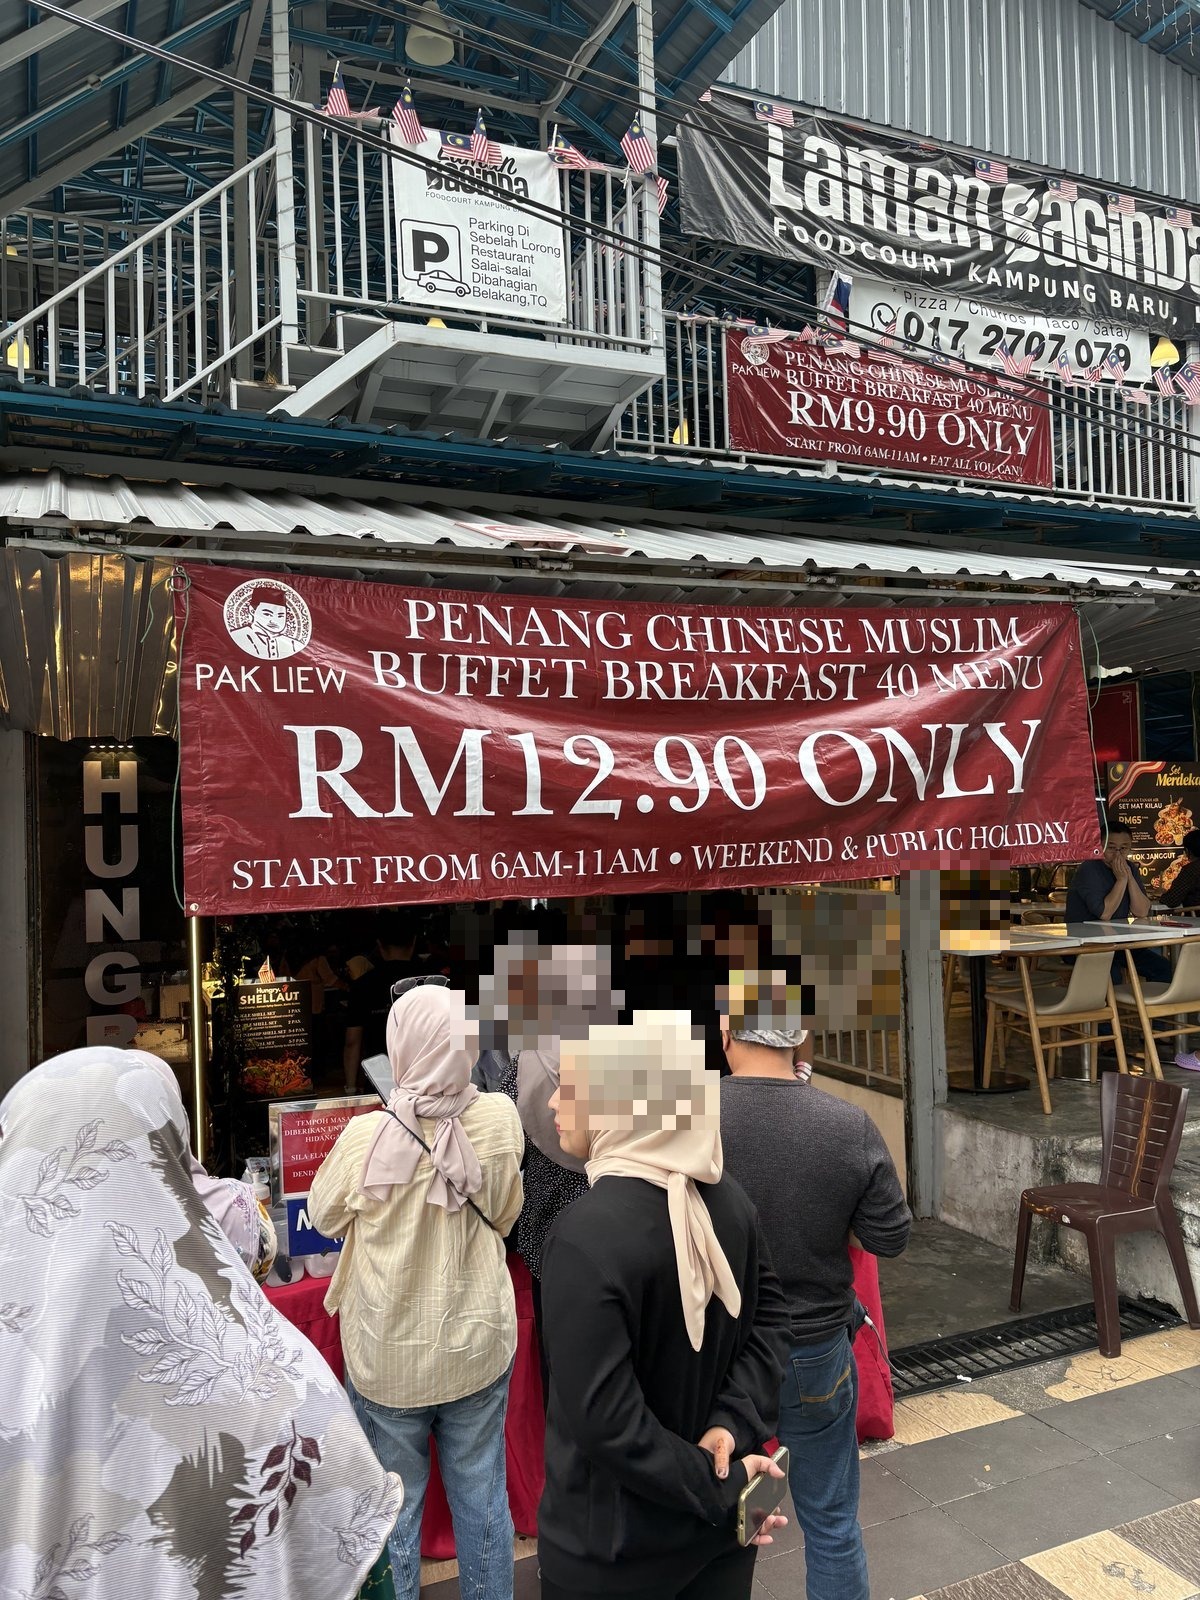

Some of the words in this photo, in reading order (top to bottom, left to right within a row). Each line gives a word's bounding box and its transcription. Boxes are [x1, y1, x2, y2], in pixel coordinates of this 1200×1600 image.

[425, 191, 472, 205] FOODCOURT
[768, 123, 994, 251] Laman
[469, 217, 514, 236] Parking
[518, 225, 530, 237] Di
[470, 231, 518, 249] Sebelah
[522, 239, 561, 258] Lorong
[471, 245, 535, 265] Restaurant
[471, 258, 532, 277] Salai-salai
[472, 272, 538, 292] Dibahagian
[773, 216, 956, 277] FOODCOURT
[968, 262, 1097, 303] KAMPUNG
[1110, 289, 1178, 325] BARU,
[473, 286, 548, 308] Belakang,TQ
[903, 290, 949, 312] Pizza
[968, 300, 1027, 326] Churros
[1093, 322, 1132, 342] Satay
[903, 311, 970, 351] 017
[979, 325, 1066, 362] 2707
[1074, 338, 1132, 372] 079
[732, 363, 755, 376] PAK
[785, 351, 864, 376] PENANG
[867, 363, 947, 390] CHINESE
[786, 369, 860, 393] BUFFET
[864, 380, 963, 411] BREAKFAST
[966, 397, 985, 414] 40
[988, 400, 1033, 422] MENU
[786, 390, 927, 441] RM9.90
[937, 412, 1035, 457] ONLY
[785, 436, 826, 451] START
[828, 442, 862, 457] FROM
[864, 446, 920, 464] 6AM-11AM
[930, 454, 952, 468] EAT
[952, 459, 972, 471] ALL
[974, 461, 996, 473] YOU
[403, 598, 633, 650] PENANG
[646, 614, 851, 655] CHINESE
[858, 616, 1028, 654] MUSLIM
[195, 663, 262, 694] PAK
[272, 666, 347, 694] LIEW
[368, 650, 587, 699] BUFFET
[601, 660, 866, 701] BREAKFAST
[876, 663, 919, 701] 40
[928, 655, 1044, 694] MENU
[283, 724, 767, 820] RM12.90
[798, 719, 1042, 807] ONLY
[232, 856, 362, 890] START
[372, 852, 481, 885] FROM
[490, 846, 660, 880] 6AM-11AM
[691, 837, 833, 872] WEEKEND
[841, 836, 859, 861] &
[866, 827, 963, 859] PUBLIC
[969, 821, 1070, 850] HOLIDAY
[240, 992, 300, 1005] SHELLAUT
[284, 1127, 326, 1136] DIBERIKAN
[296, 1118, 329, 1126] TEMPOH
[291, 1153, 308, 1161] SILA
